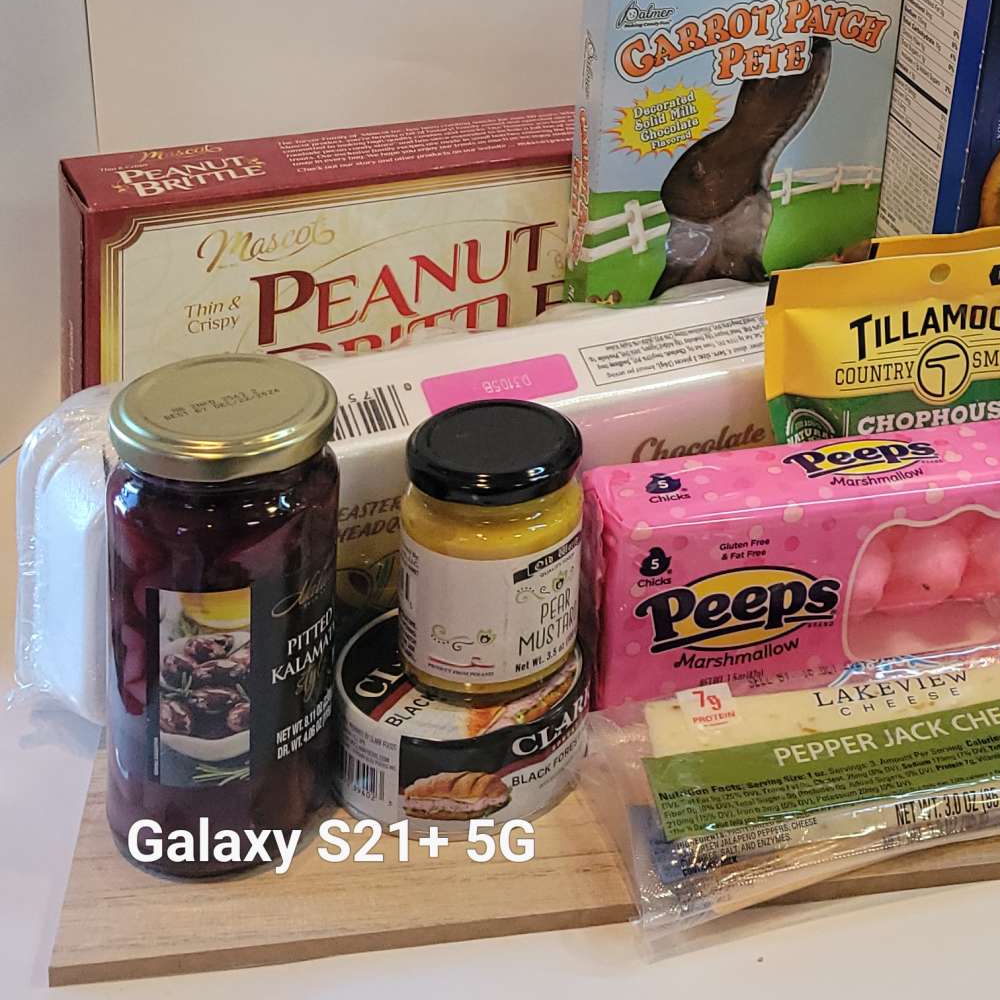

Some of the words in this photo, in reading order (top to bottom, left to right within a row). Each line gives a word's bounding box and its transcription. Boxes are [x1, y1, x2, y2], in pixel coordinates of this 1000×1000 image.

[619, 3, 776, 78] CARROT
[716, 40, 806, 81] PETE
[633, 90, 696, 119] Decorated
[635, 113, 666, 131] Solid
[670, 104, 698, 121] Milk
[640, 118, 700, 142] Chocolate
[650, 130, 693, 151] Flavored
[117, 156, 244, 184] PEANUT
[127, 165, 267, 197] BRITTLE
[249, 220, 558, 346] PEANUT
[185, 300, 224, 319] Thin
[228, 295, 242, 311] &
[187, 313, 241, 335] Crispy
[481, 374, 533, 395] D3105B
[834, 361, 916, 386] COUNTRY
[631, 423, 767, 464] Chocolate
[783, 440, 937, 474] Peeps
[657, 479, 669, 489] 5
[830, 467, 924, 487] Marshmallow
[339, 495, 402, 522] EASTER
[649, 493, 692, 504] Chicks
[719, 541, 749, 552] Gluten
[750, 538, 770, 548] Free
[721, 553, 729, 561] &
[730, 551, 745, 561] Fat
[747, 549, 767, 559] Free
[650, 558, 660, 570] 5
[637, 577, 672, 588] Chicks
[541, 587, 571, 625] PEAR
[635, 579, 841, 643] Peeps
[288, 607, 333, 656] PITTED
[519, 606, 578, 657] MUSTAR
[271, 618, 335, 685] KALAMAT
[515, 660, 530, 673] Net
[532, 654, 545, 667] Wt.
[546, 647, 558, 661] 3.5
[673, 638, 800, 669] Marshmallow
[691, 690, 722, 711] 7g
[812, 669, 968, 707] LAKEVIEW
[840, 687, 960, 717] CHEESE
[692, 710, 737, 724] PROTEIN
[276, 725, 292, 745] NET
[291, 719, 304, 736] WT.
[774, 731, 880, 768] PEPPER
[884, 717, 950, 749] JACK
[277, 743, 291, 760] DR.
[290, 735, 303, 752] WT.
[511, 764, 551, 787] BLACK
[894, 801, 917, 827] NET
[943, 793, 962, 817] 3.0
[963, 790, 979, 813] OZ
[791, 817, 818, 830] CHEESE
[740, 840, 756, 852] AND
[757, 833, 793, 848] ENZYMES.
